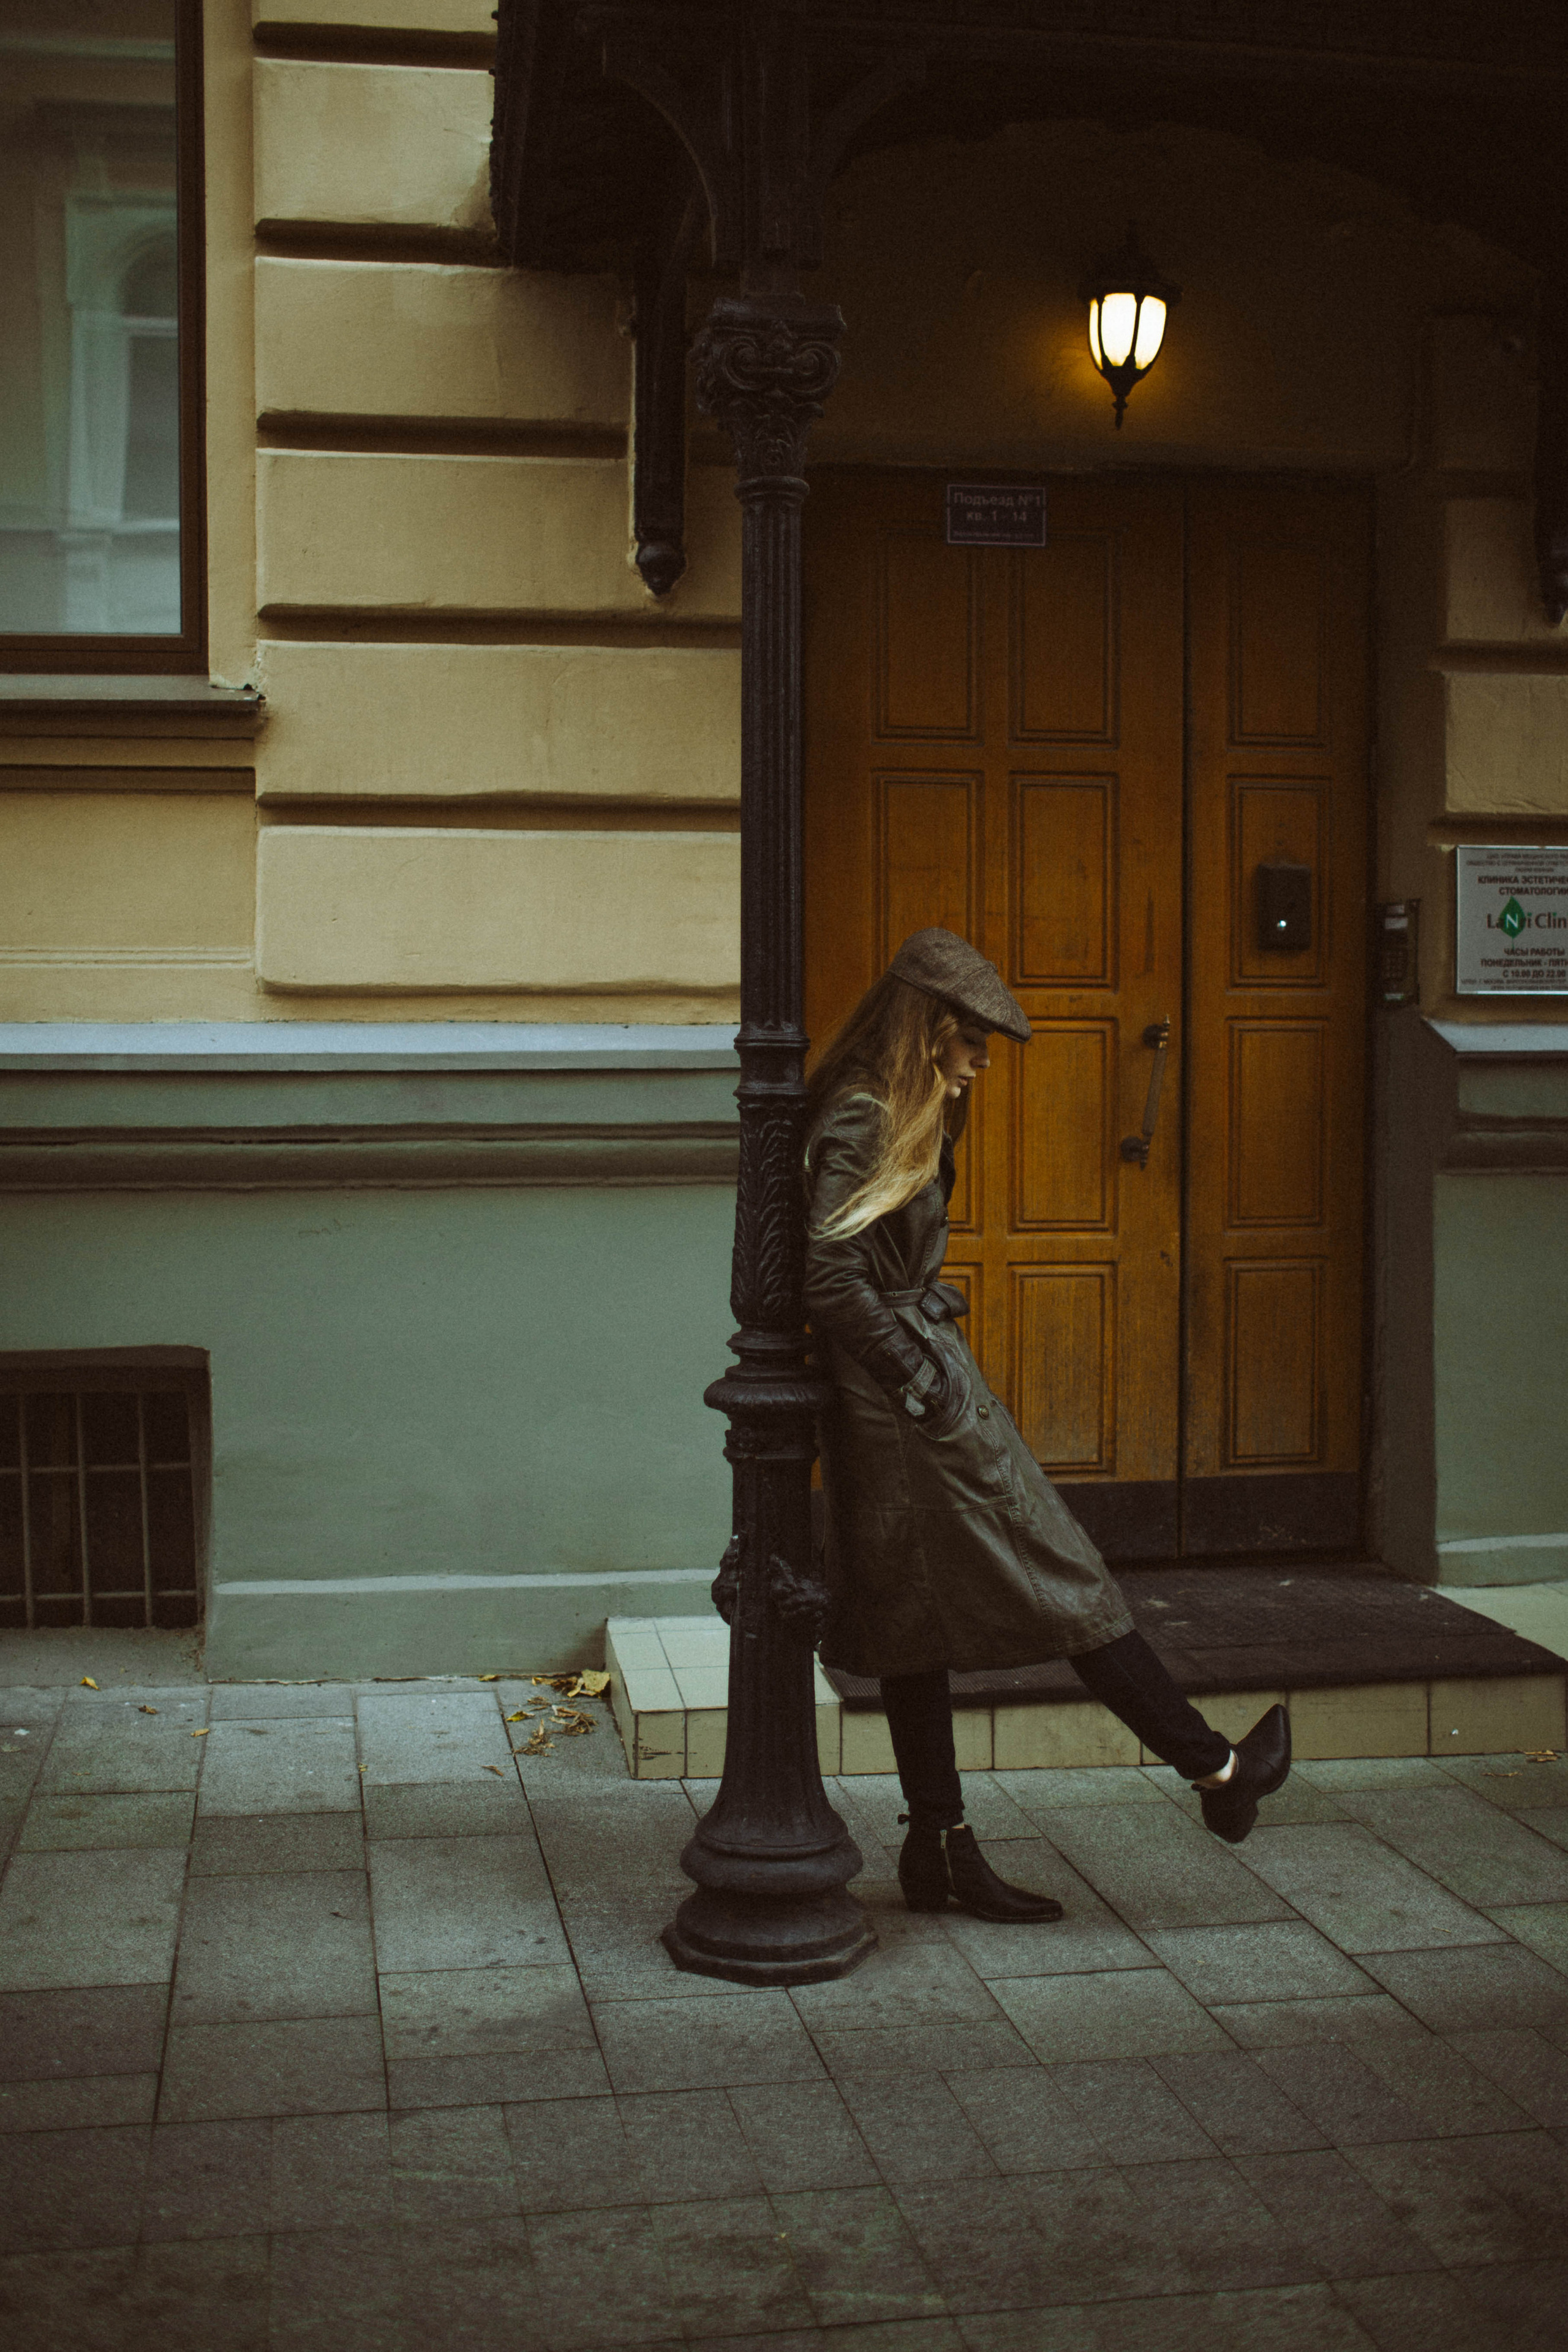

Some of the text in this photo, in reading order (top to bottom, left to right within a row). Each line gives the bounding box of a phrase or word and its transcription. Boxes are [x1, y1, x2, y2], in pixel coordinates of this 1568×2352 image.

[967, 511, 986, 521] кв.
[1013, 511, 1027, 522] 14
[1477, 875, 1519, 884] КЛИНИКА
[1535, 912, 1568, 929] Clin
[1504, 948, 1565, 956] ЧАСЫ РАБОТЫ
[1480, 959, 1542, 968] ПОНЕДЕЛЬНИК
[1532, 970, 1544, 978] ДО
